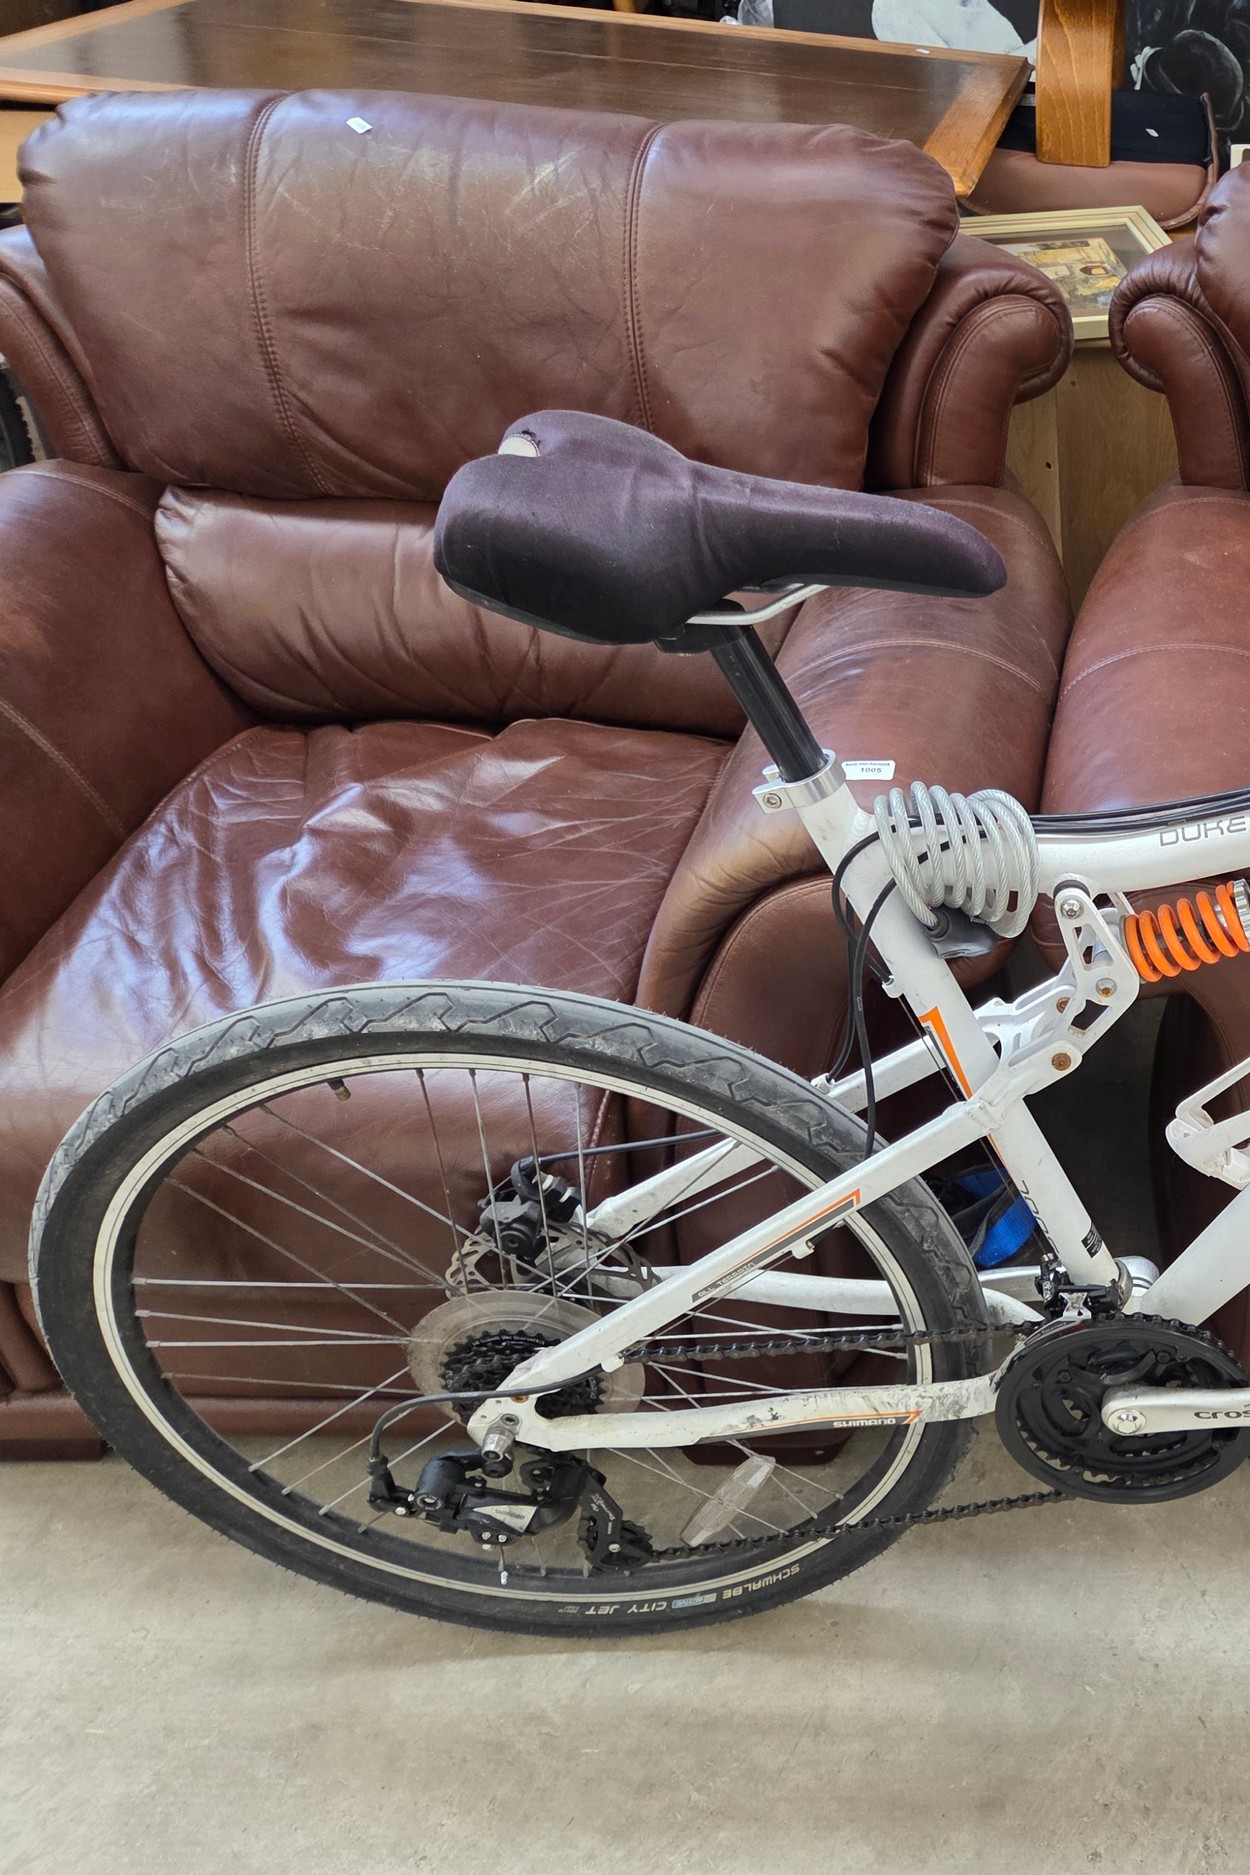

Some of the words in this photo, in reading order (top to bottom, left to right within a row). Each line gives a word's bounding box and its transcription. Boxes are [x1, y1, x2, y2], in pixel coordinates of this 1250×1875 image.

[1160, 815, 1247, 847] DUKE
[832, 1417, 897, 1429] SHIMANO
[722, 1563, 801, 1600] SCHWALBE
[584, 1604, 620, 1615] JET
[626, 1601, 668, 1614] CITY
